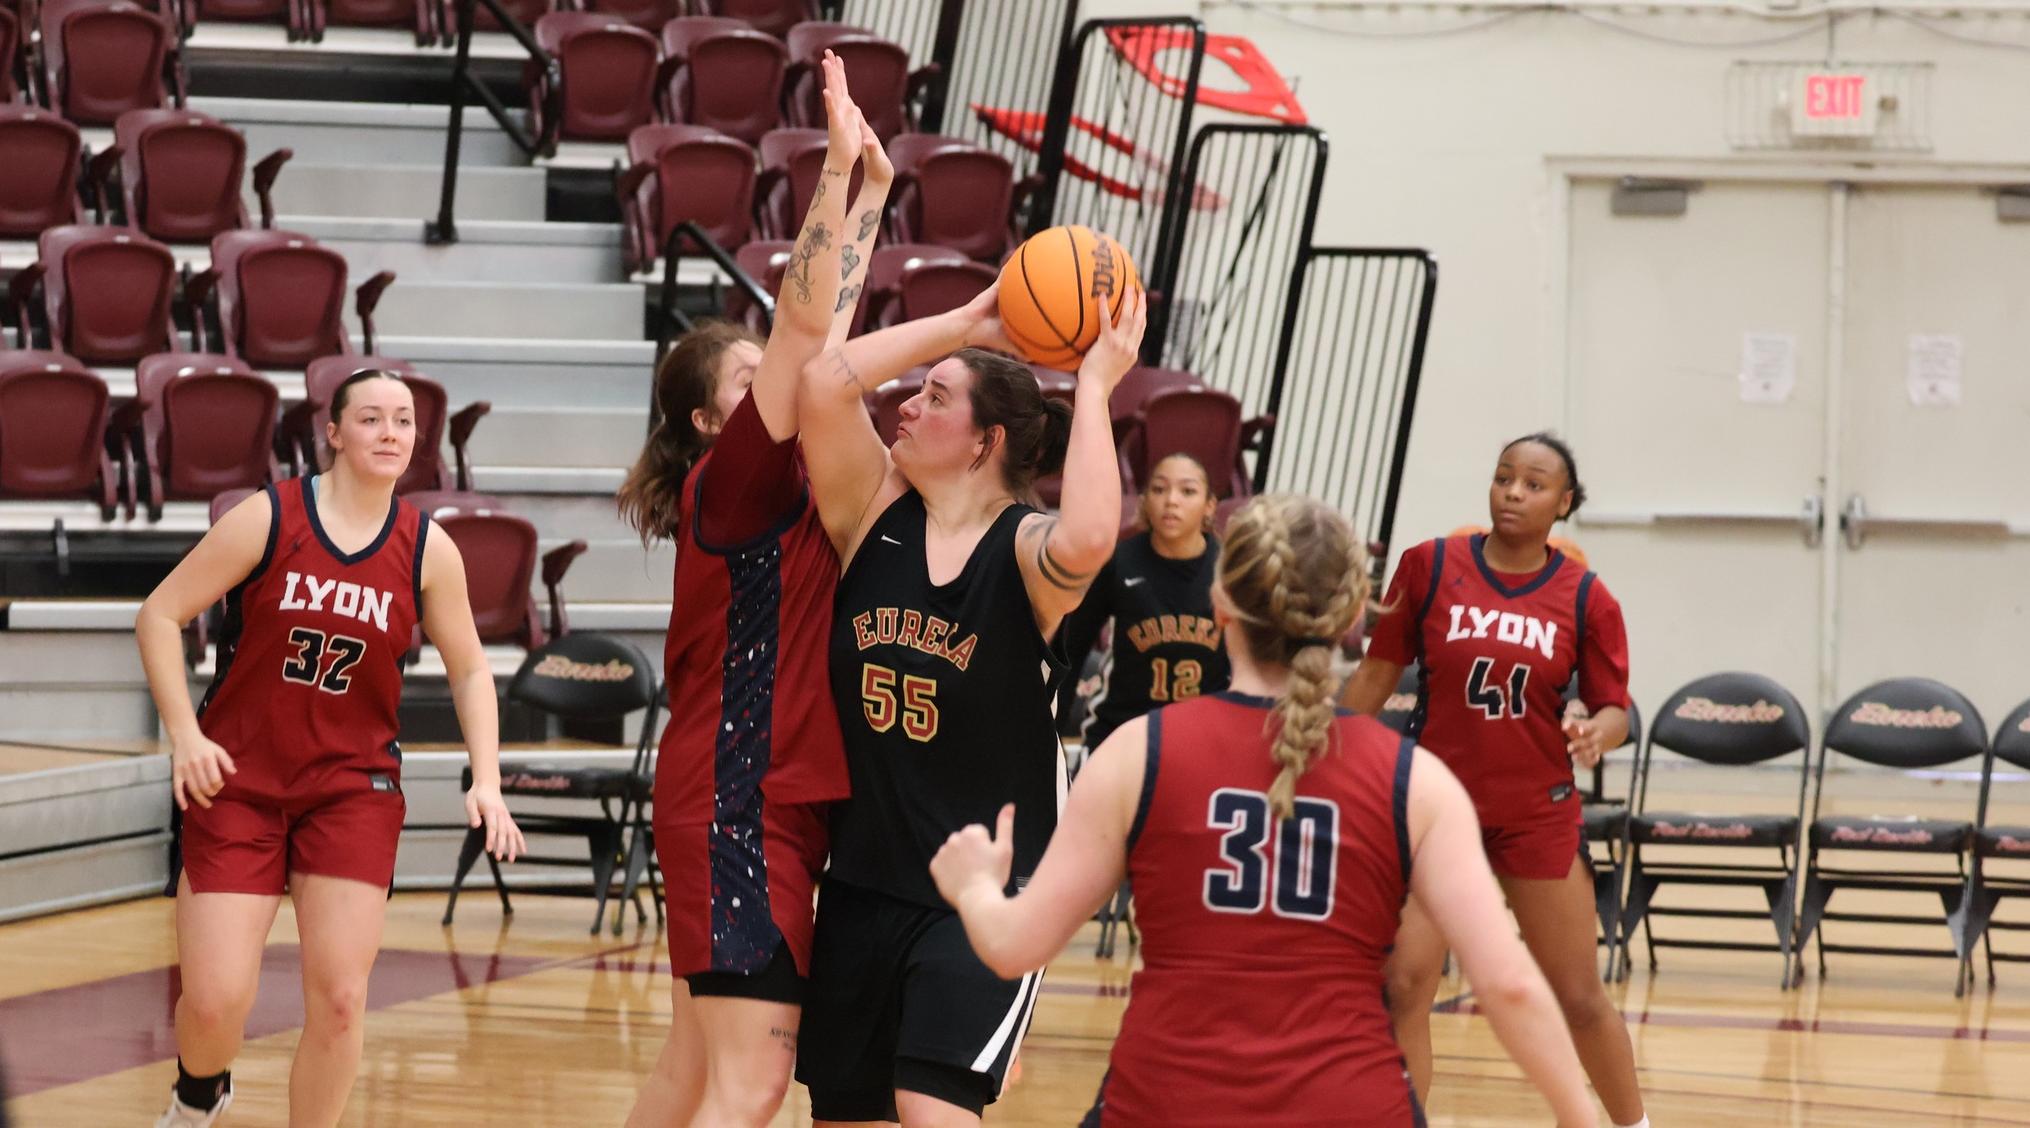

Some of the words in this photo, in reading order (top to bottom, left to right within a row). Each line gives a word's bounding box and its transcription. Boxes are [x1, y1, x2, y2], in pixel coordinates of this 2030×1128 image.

[1806, 75, 1865, 118] EXIT
[279, 571, 393, 633] LYON
[1446, 604, 1558, 660] LYON
[282, 626, 367, 695] 32
[1150, 657, 1202, 702] 12
[1465, 656, 1531, 720] 41
[862, 662, 939, 743] 55
[1202, 787, 1340, 923] 30
